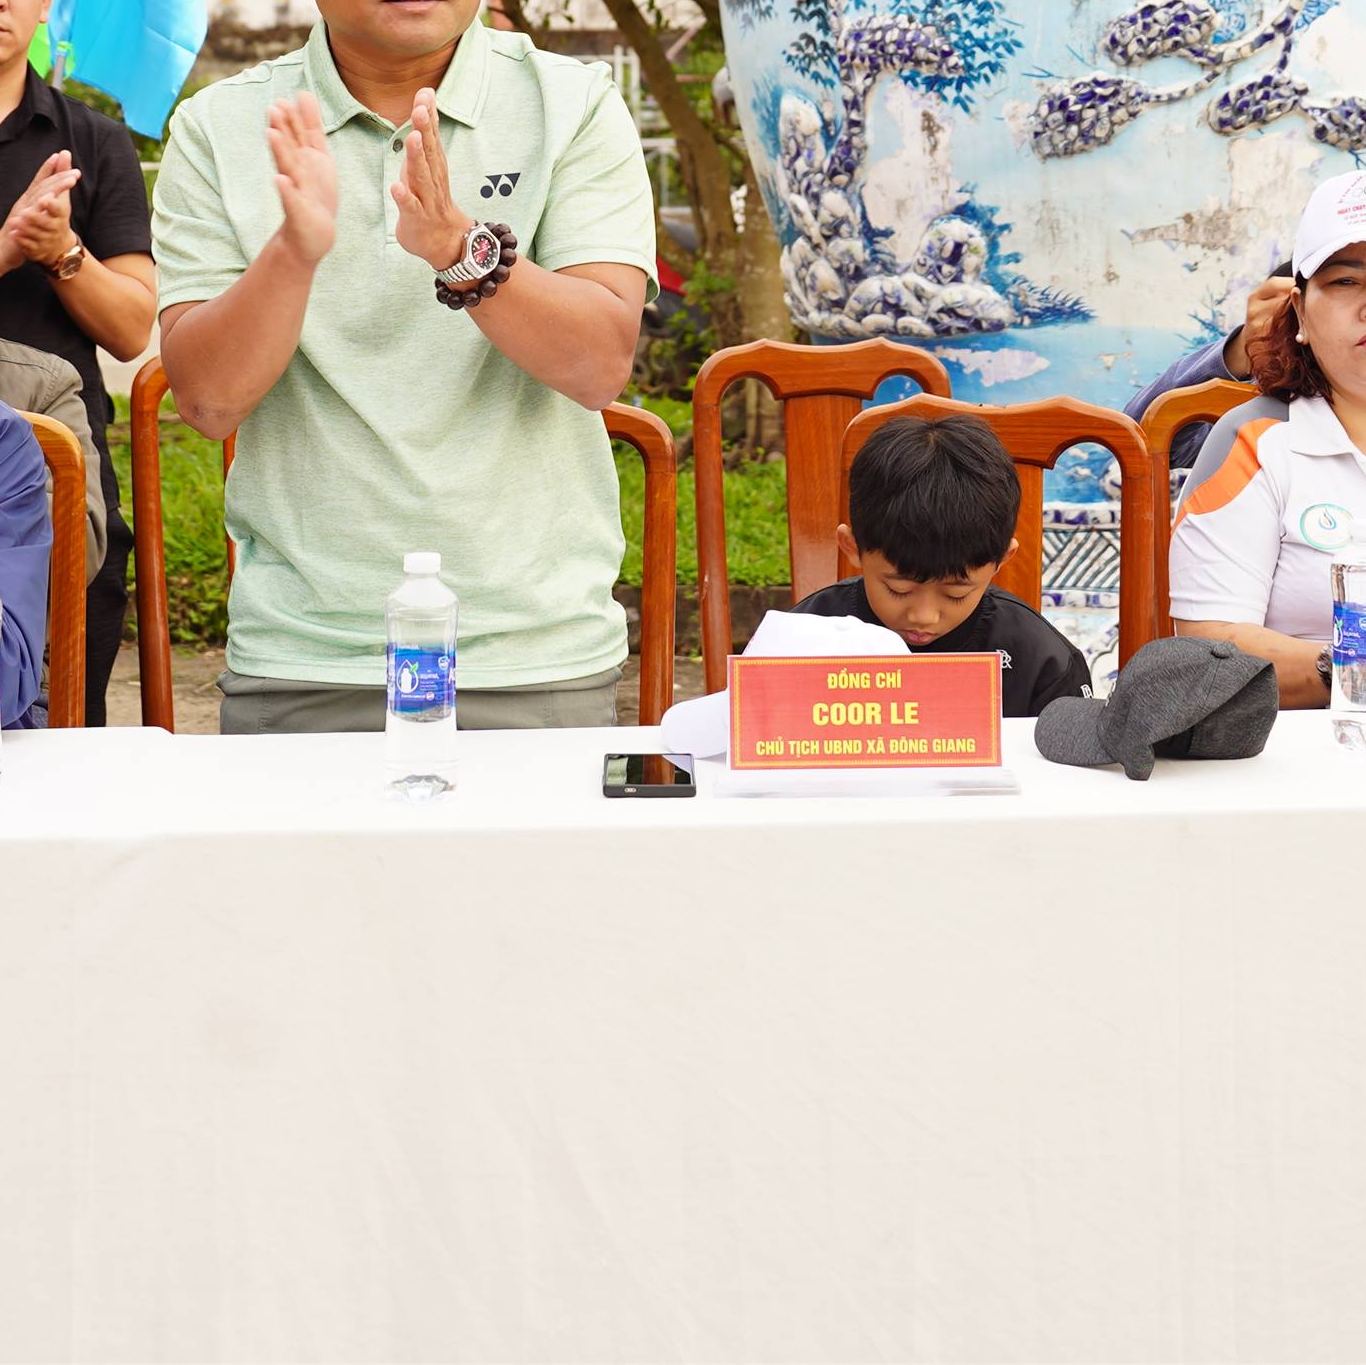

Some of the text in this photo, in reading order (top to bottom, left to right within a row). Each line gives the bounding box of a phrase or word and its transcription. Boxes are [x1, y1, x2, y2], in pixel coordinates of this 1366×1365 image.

[876, 669, 901, 688] CHÍ
[813, 702, 919, 725] COOR LE
[756, 736, 975, 758] CHỦ TỊCH UBND XÃ ĐÔNG GIANG
